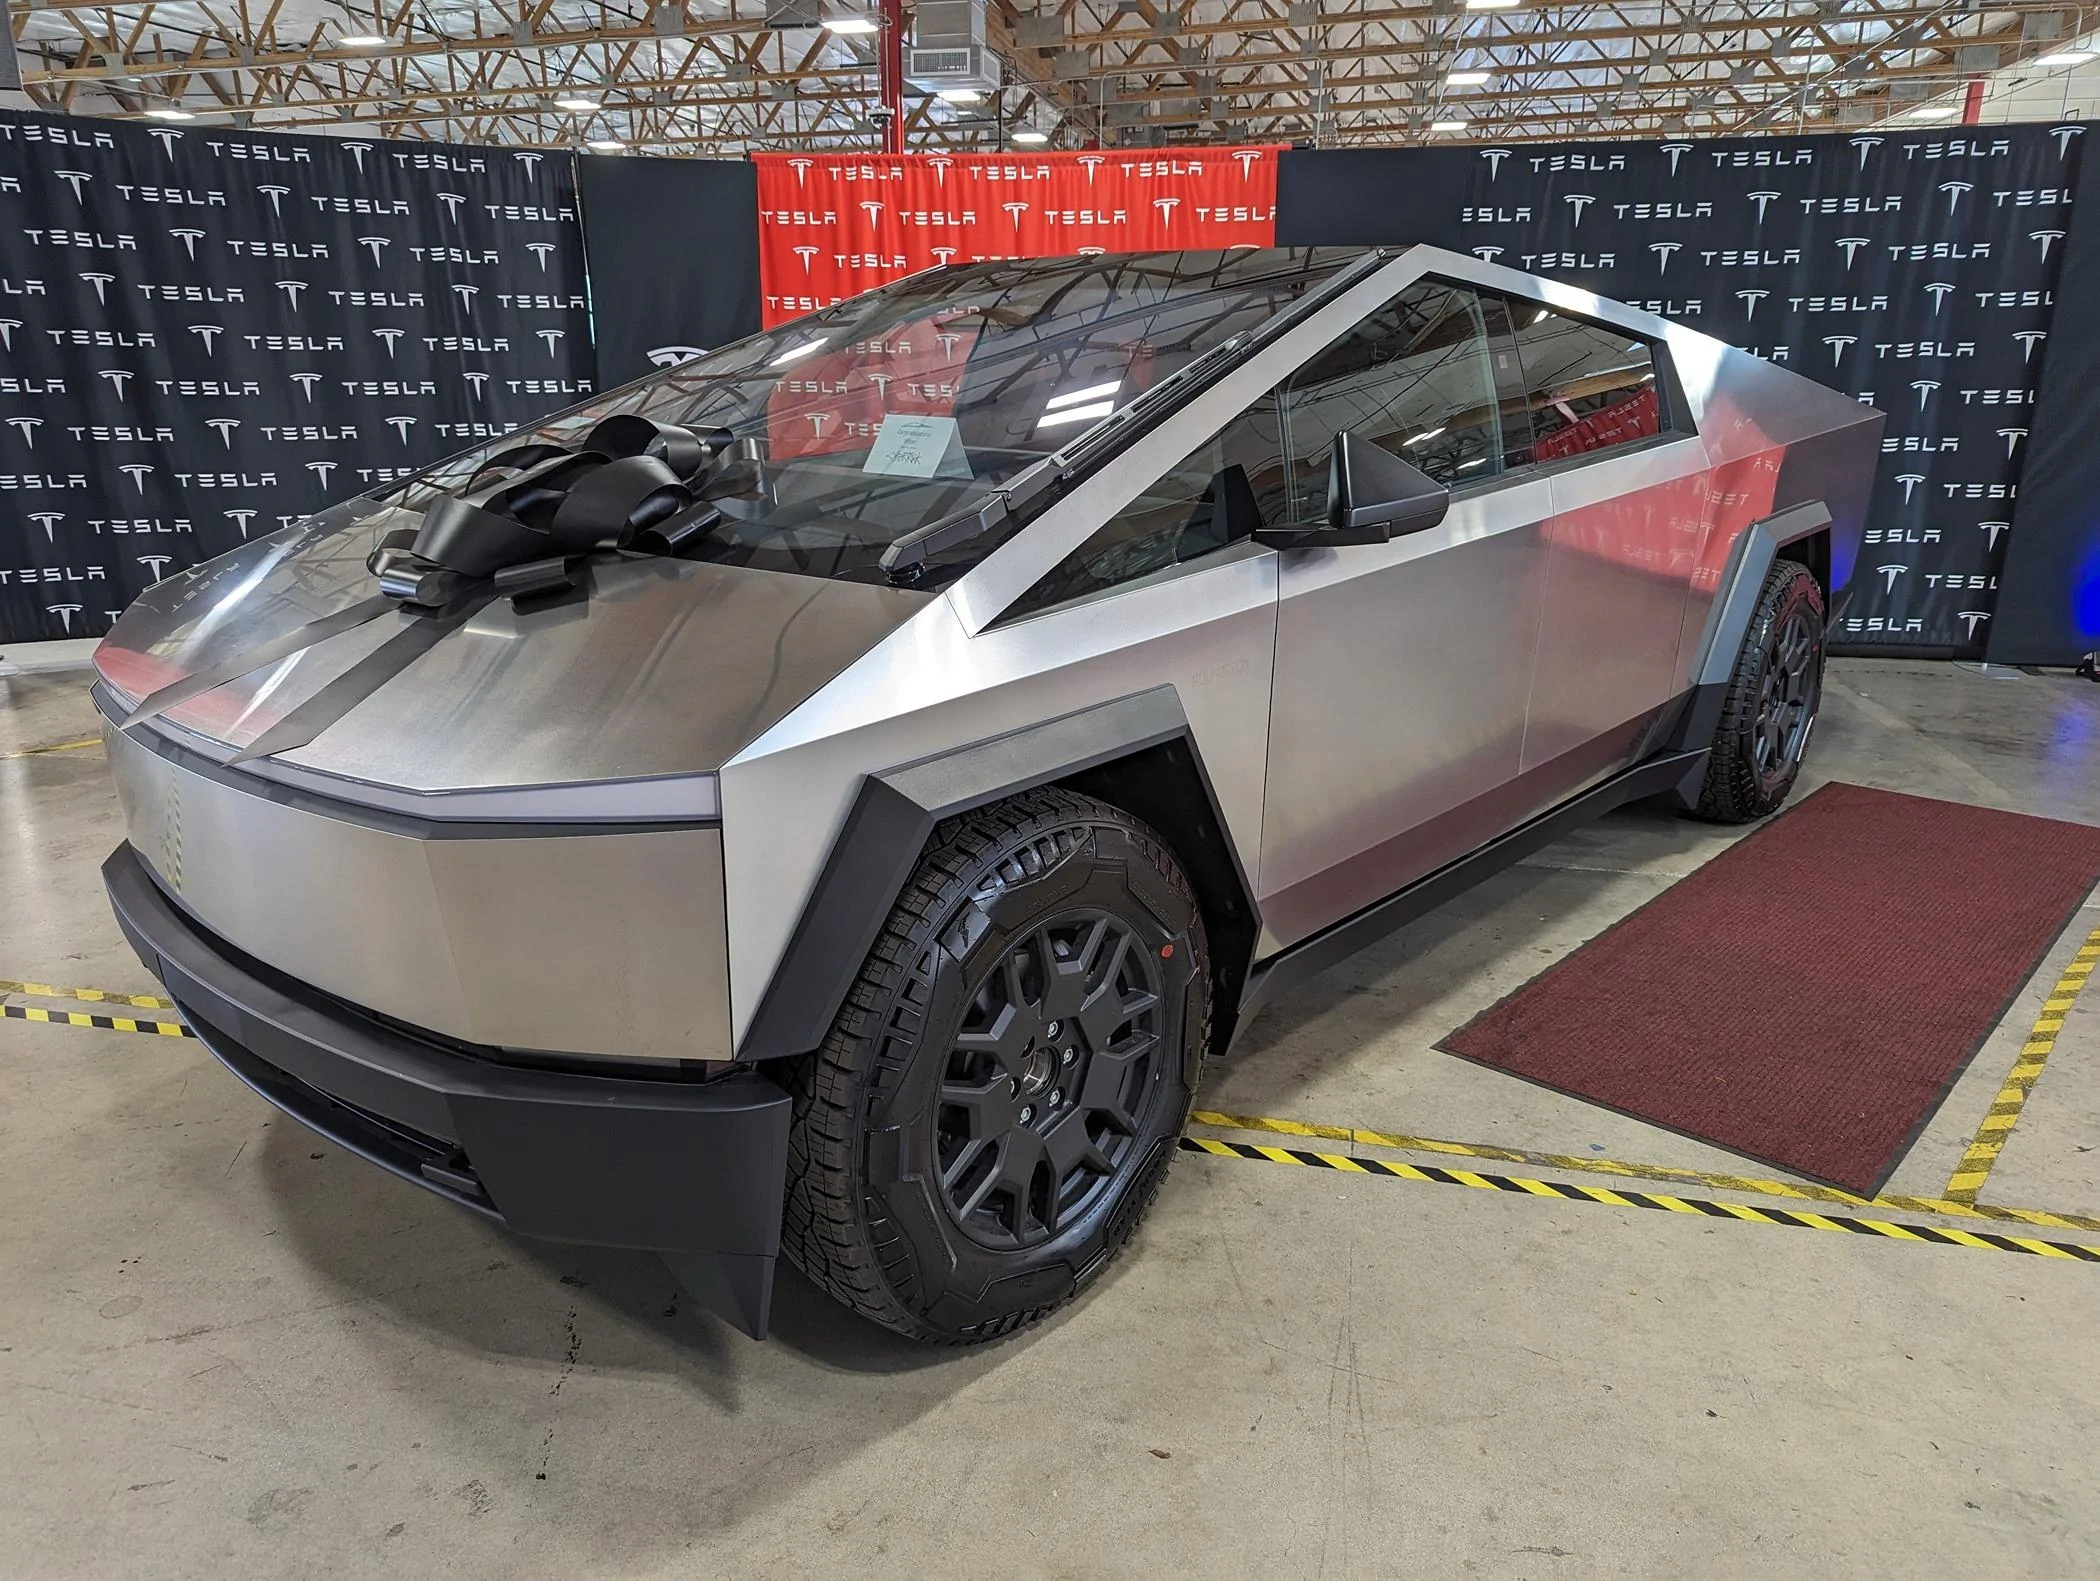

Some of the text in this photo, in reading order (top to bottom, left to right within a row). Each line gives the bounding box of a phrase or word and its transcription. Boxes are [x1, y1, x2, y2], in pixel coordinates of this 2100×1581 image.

[0, 124, 115, 149] TESLA
[205, 141, 311, 163] TESLA
[1903, 139, 2010, 160] TESLA
[392, 153, 486, 173] TESLA
[1528, 154, 1626, 173] TESLA
[1711, 149, 1813, 167] TESLA
[828, 165, 903, 181] TESLA
[969, 165, 1050, 181] TESLA
[1120, 160, 1203, 178] TESLA
[115, 184, 226, 207] TESLA
[1992, 188, 2073, 207] TESL
[310, 196, 410, 216] TESLA
[1613, 202, 1713, 220] TESLA
[1799, 195, 1902, 214] TESLA
[485, 205, 574, 221] TESLA
[761, 210, 837, 225] TESLA
[899, 211, 976, 226] TESLA
[1044, 209, 1126, 225] TESLA
[1462, 207, 1532, 223] ESLA
[23, 229, 137, 251] TESLA
[226, 240, 329, 259] TESLA
[408, 247, 499, 264] TESLA
[1700, 248, 1801, 266] TESLA
[1888, 242, 1991, 261] TESLA
[833, 253, 907, 269] TESLA
[1522, 253, 1615, 269] TESLA
[136, 284, 245, 303] TESLA
[327, 290, 425, 307] TESLA
[496, 294, 585, 309] TESLA
[1975, 290, 2053, 308] TESL
[1788, 295, 1889, 313] TESLA
[46, 329, 156, 348] TESLA
[243, 335, 344, 351] TESLA
[422, 336, 510, 352] TESLA
[1874, 341, 1976, 359] TESLA
[0, 377, 66, 394] SLA
[155, 380, 260, 396] TESLA
[341, 381, 436, 396] TESLA
[505, 379, 592, 394] TESLA
[775, 381, 848, 394] TESLA
[1960, 389, 2034, 405] TESL
[66, 426, 174, 442] TESLA
[259, 426, 358, 441] TESLA
[1881, 436, 1960, 453] ESLA
[0, 474, 87, 490] ESLA
[174, 472, 277, 488] TESLA
[1943, 483, 2017, 499] TESL
[87, 518, 193, 534] TESLA
[1864, 528, 1942, 544] ESLA
[1924, 574, 1997, 590] TESL
[1841, 618, 1923, 632] ESLA
